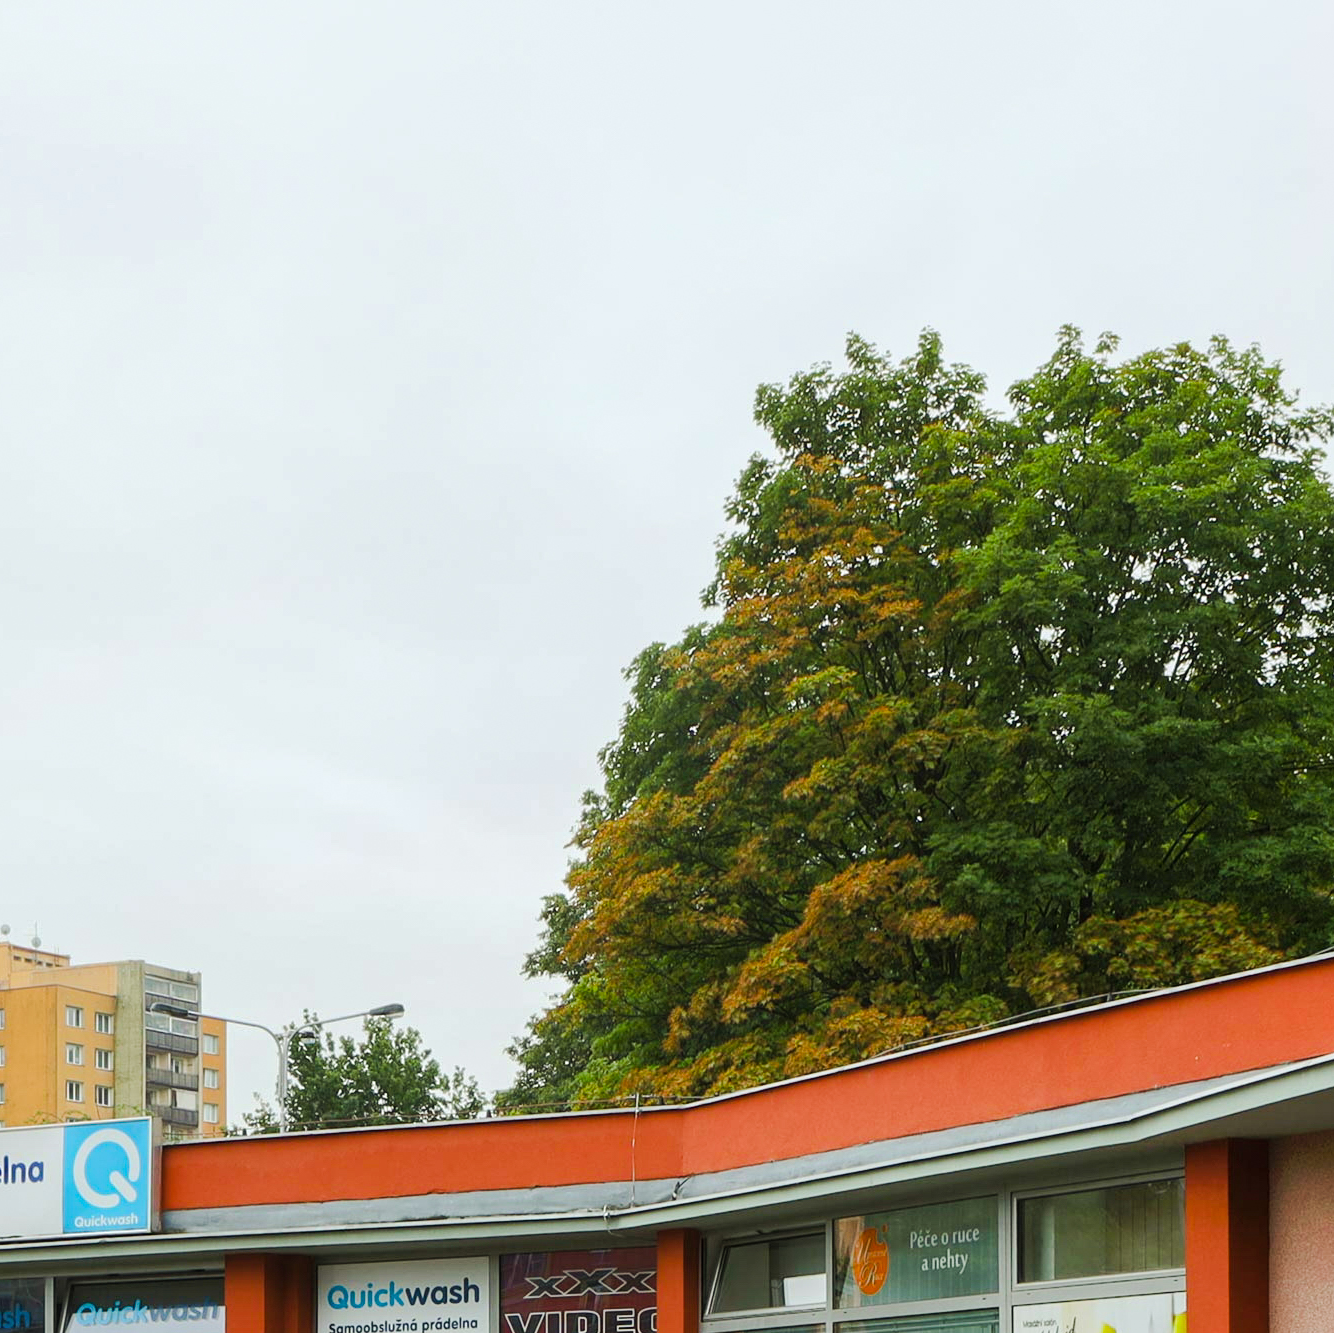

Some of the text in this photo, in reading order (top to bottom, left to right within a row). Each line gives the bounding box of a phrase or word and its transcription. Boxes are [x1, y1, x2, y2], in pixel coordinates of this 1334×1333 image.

[74, 1212, 139, 1229] Quickwash
[909, 1227, 980, 1249] Péče o ruce
[921, 1248, 968, 1274] a nehty
[327, 1276, 480, 1310] Quickwash
[75, 1296, 218, 1327] Quickwash
[422, 1317, 478, 1333] prádelna
